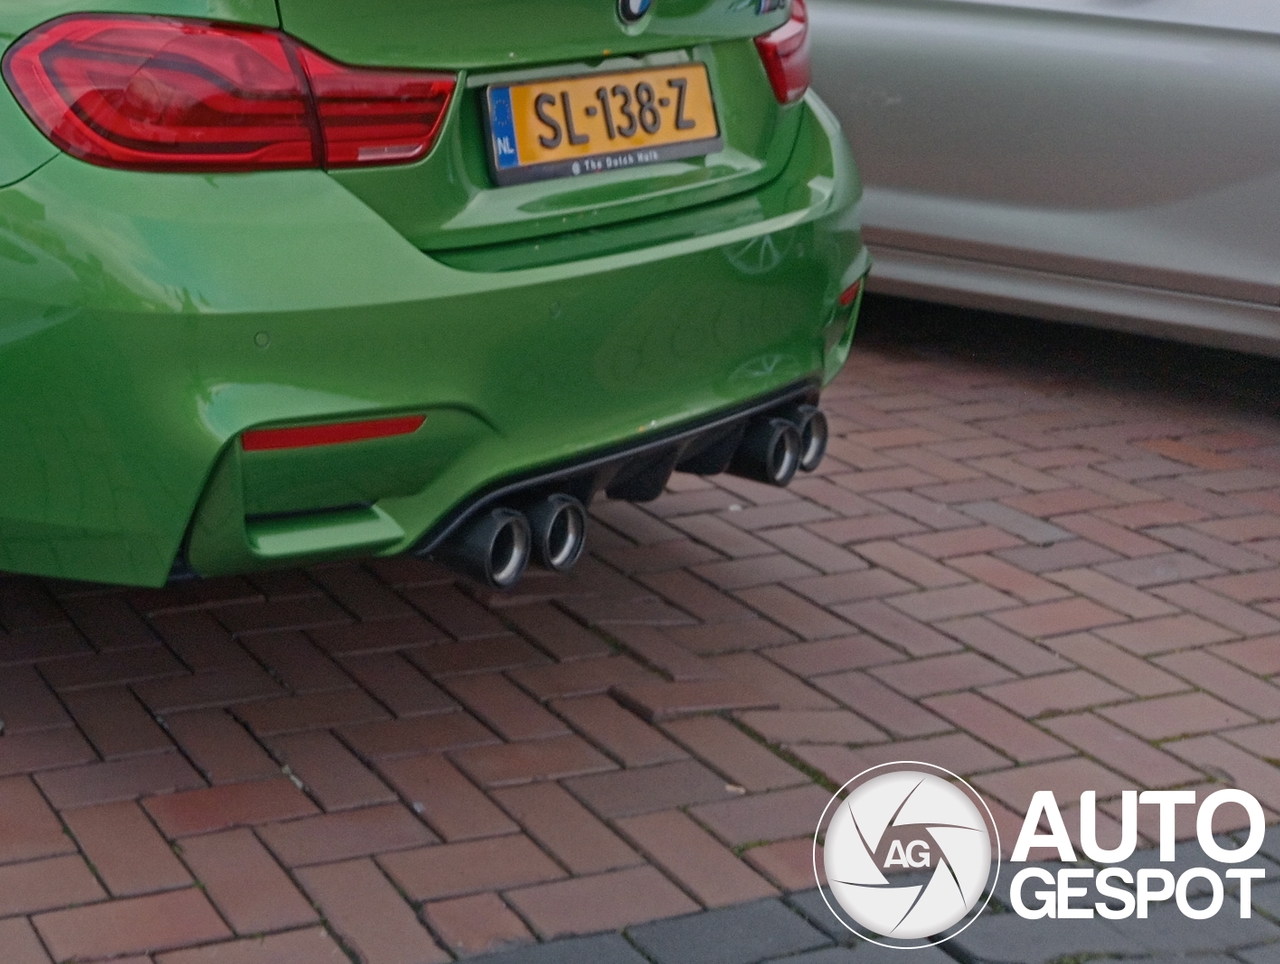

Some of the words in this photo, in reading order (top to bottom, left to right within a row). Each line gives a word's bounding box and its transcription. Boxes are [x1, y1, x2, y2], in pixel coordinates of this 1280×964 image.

[535, 78, 696, 149] SL-138-Z
[497, 136, 515, 156] NL
[584, 158, 603, 172] The
[605, 153, 634, 169] Dutch
